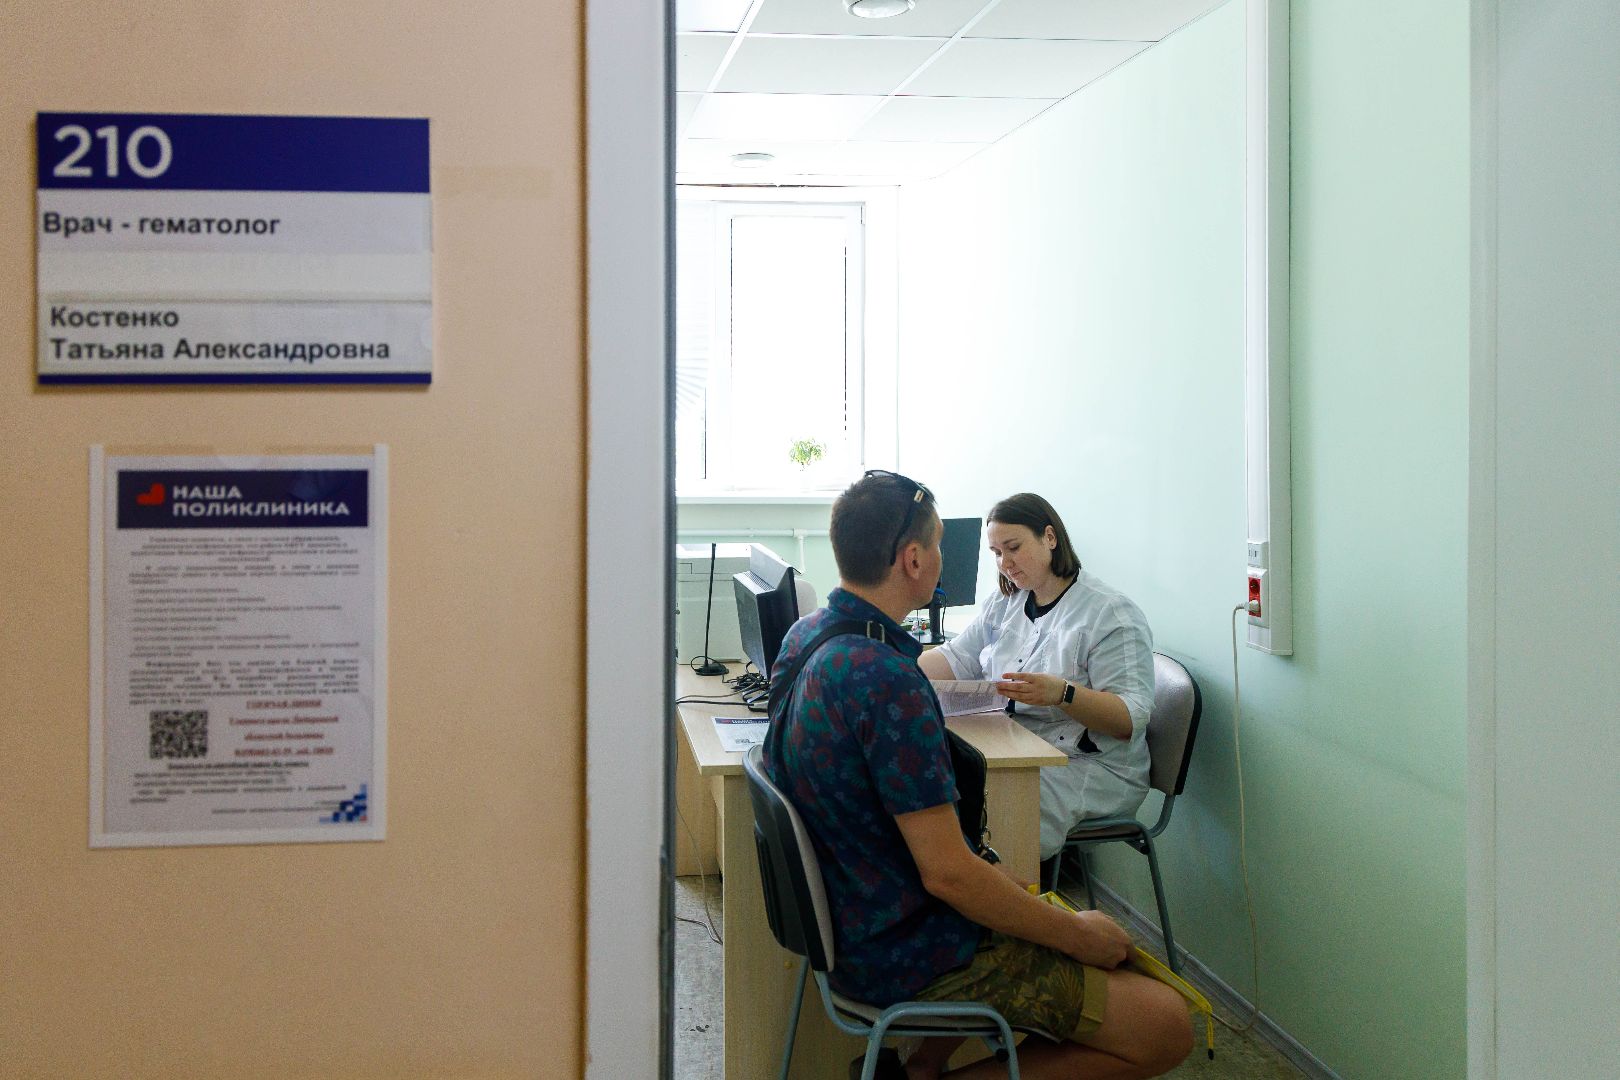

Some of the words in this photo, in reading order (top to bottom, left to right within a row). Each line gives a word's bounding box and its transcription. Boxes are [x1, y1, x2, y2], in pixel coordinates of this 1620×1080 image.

[52, 125, 173, 179] 210
[43, 212, 112, 237] Врач
[138, 215, 281, 236] гематолог
[50, 306, 179, 328] Костенко
[50, 338, 164, 360] Татьяна
[173, 338, 390, 363] Александровна
[172, 485, 243, 499] НАША
[172, 502, 350, 517] ПОЛИКЛИНИКА
